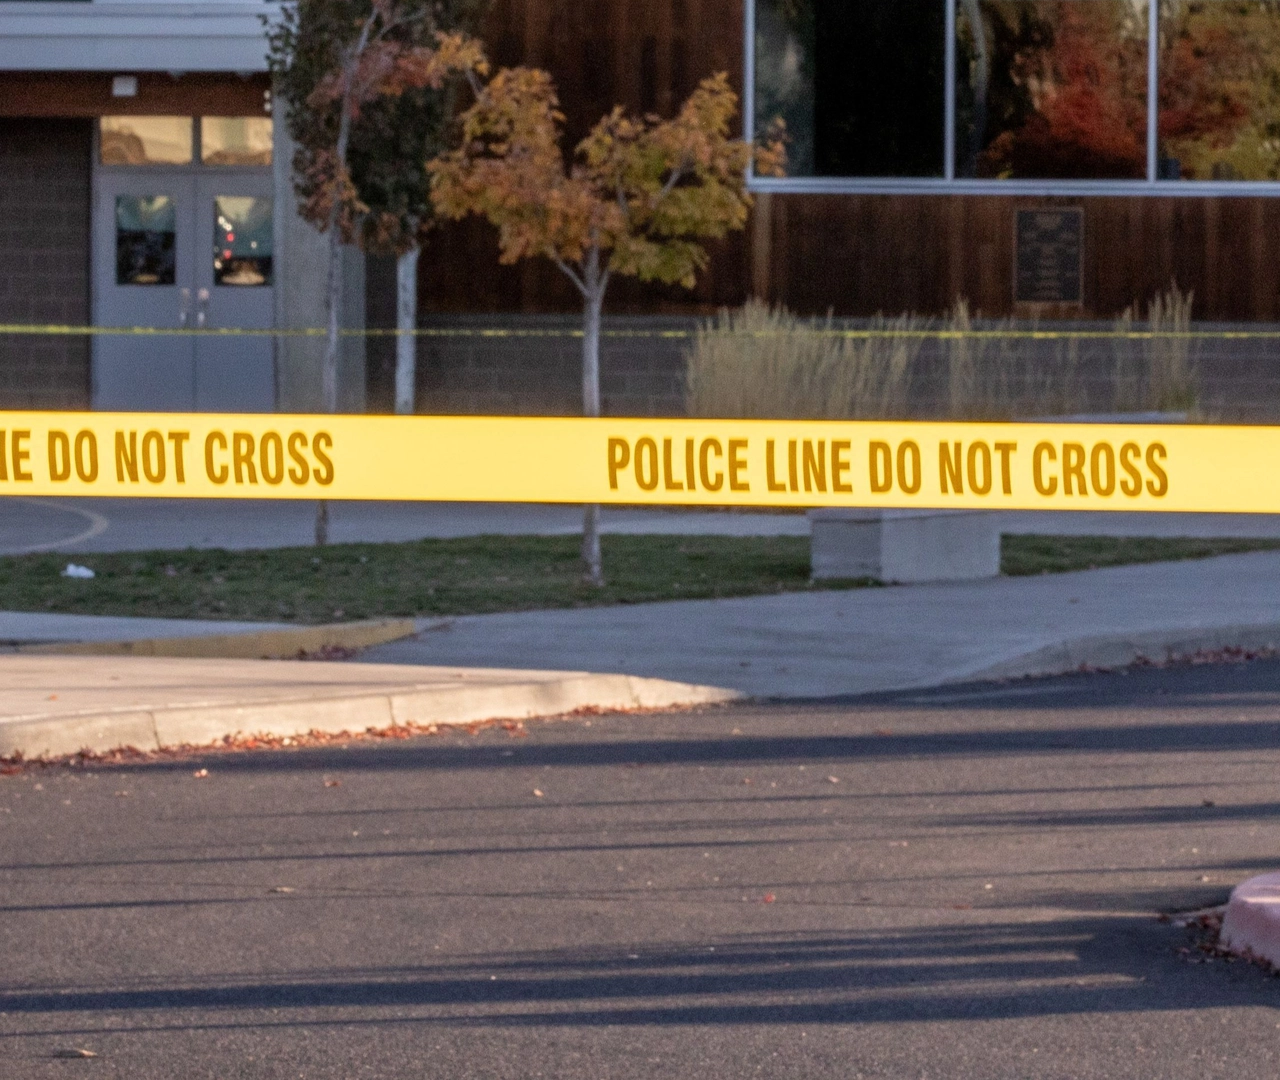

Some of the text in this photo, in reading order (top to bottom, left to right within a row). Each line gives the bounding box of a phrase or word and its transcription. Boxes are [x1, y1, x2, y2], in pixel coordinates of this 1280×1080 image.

[47, 429, 99, 484] DO
[114, 430, 190, 484] NOT
[204, 430, 335, 486] CROSS
[607, 436, 1169, 498] POLICE LINE DO NOT CROSS
